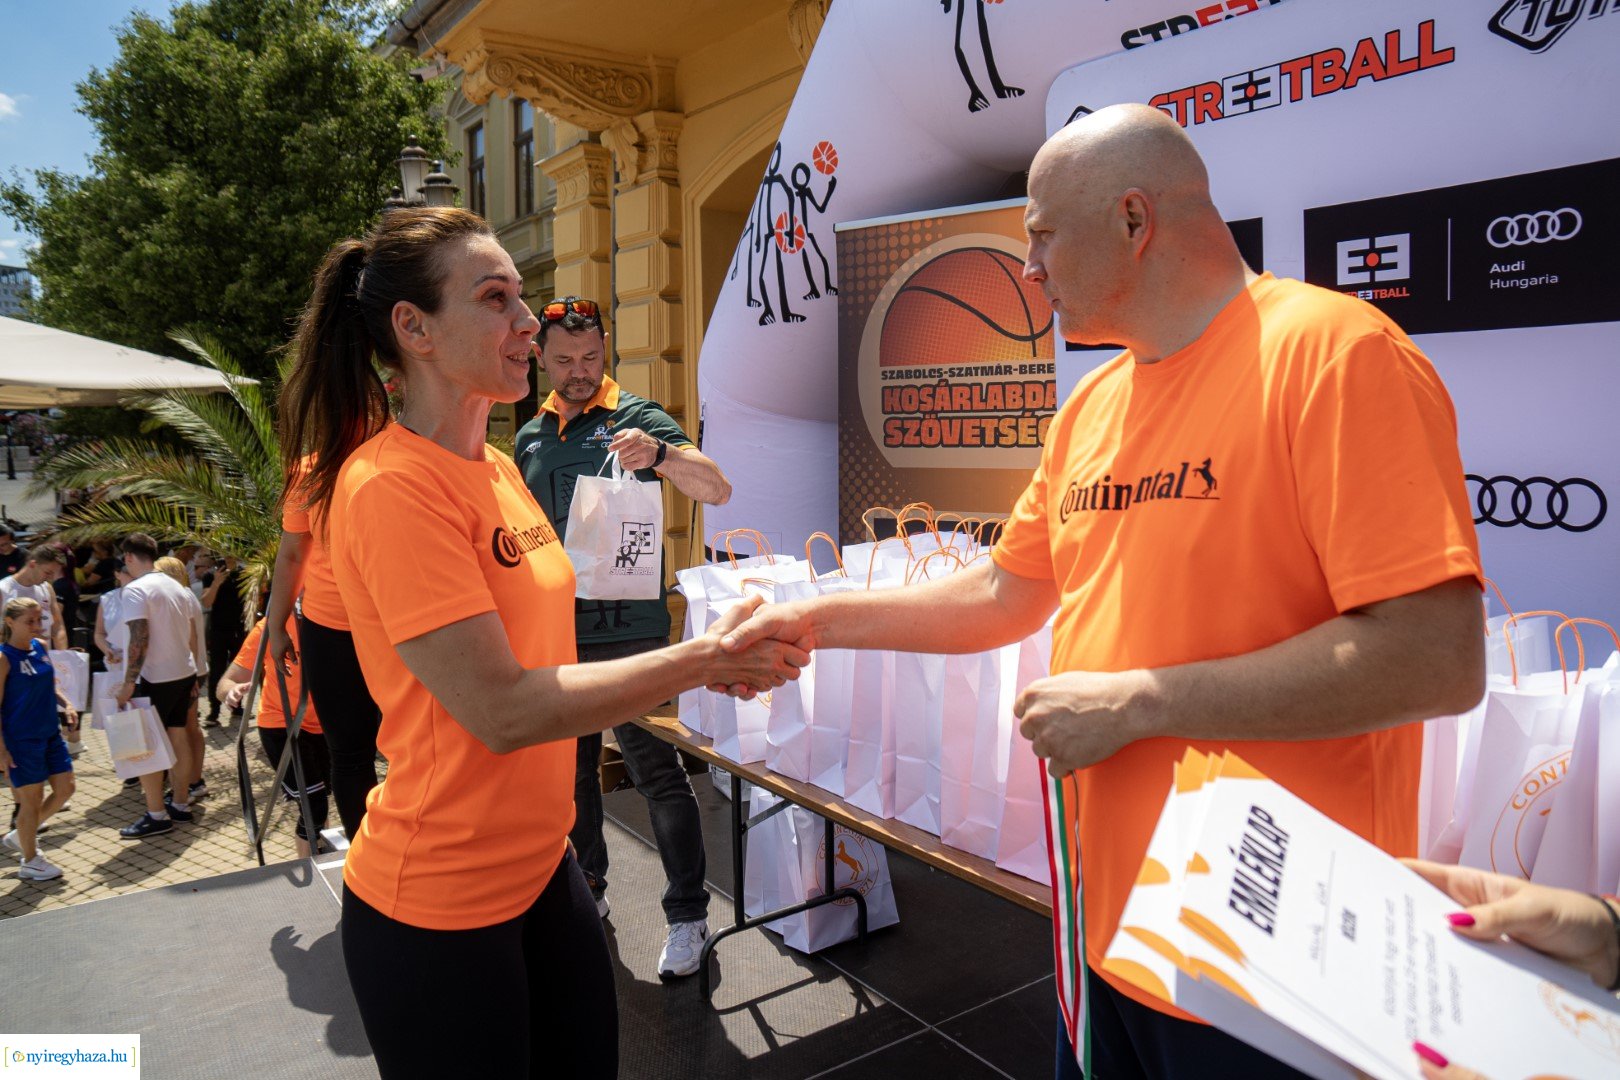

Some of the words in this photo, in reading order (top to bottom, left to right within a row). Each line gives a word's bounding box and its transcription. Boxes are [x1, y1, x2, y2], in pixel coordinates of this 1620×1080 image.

[1489, 260, 1525, 274] Audi
[1489, 274, 1559, 290] Hungaria
[1228, 804, 1290, 937] EMLÉKLAP
